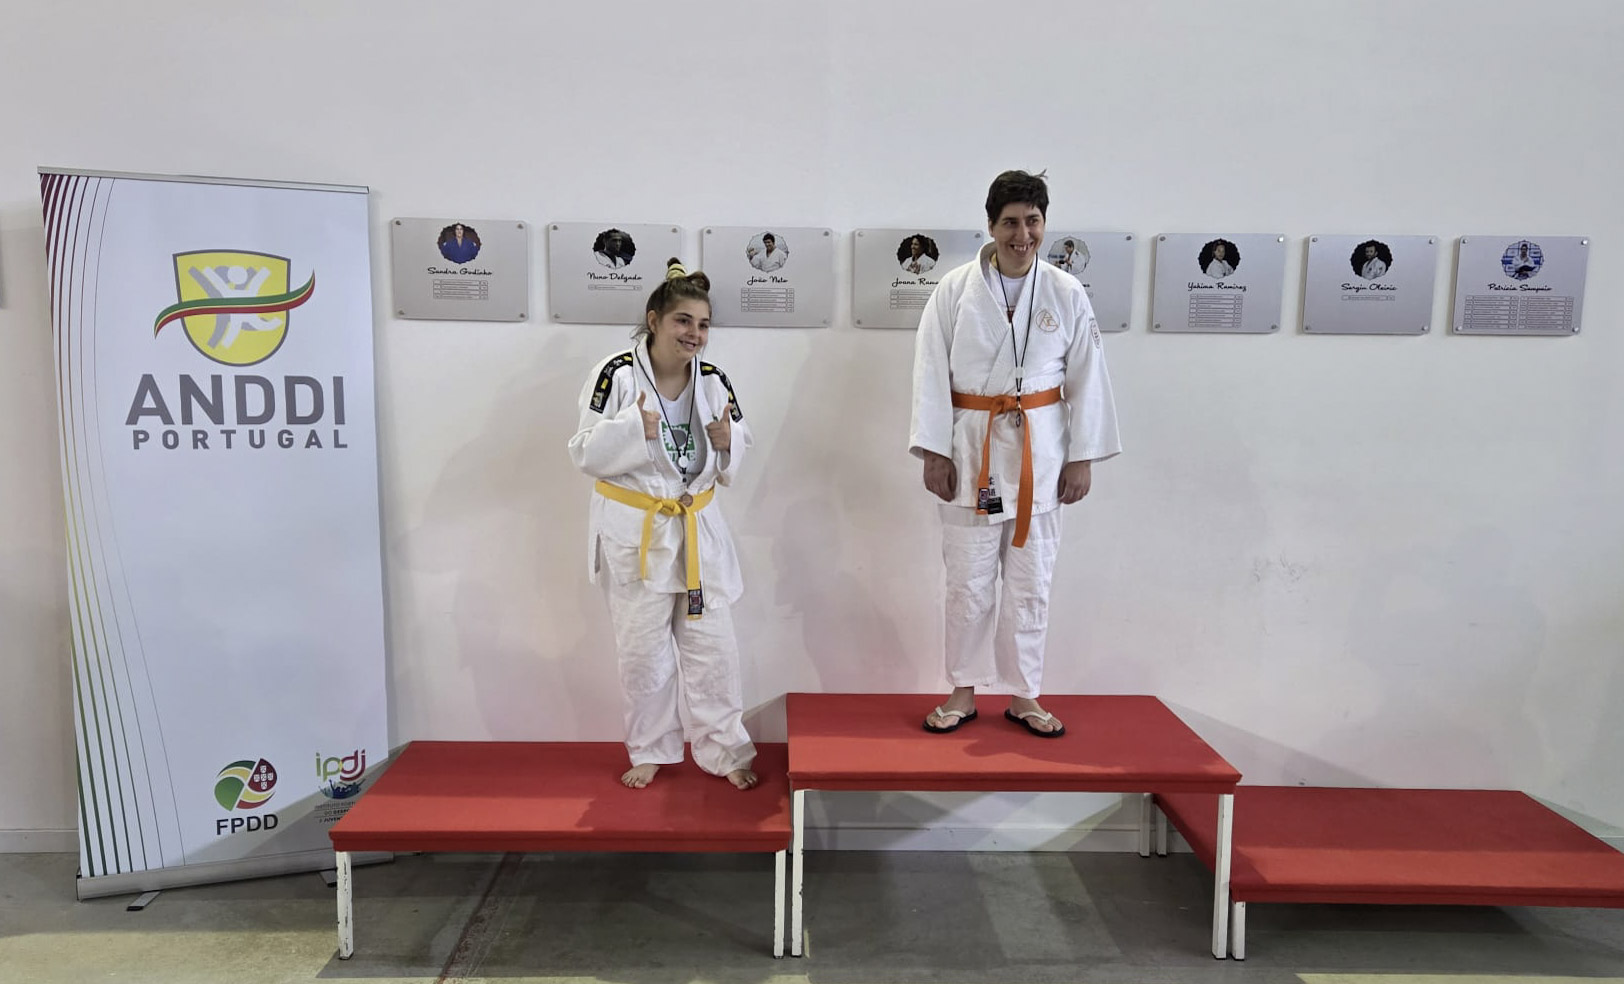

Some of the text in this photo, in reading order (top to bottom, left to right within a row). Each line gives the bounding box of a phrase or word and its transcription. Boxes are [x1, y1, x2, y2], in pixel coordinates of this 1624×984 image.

[427, 266, 493, 276] Sandra Godinho
[587, 272, 643, 283] Nuno Delgado
[769, 275, 788, 284] Neto
[891, 276, 940, 288] Joana Ramo
[1215, 281, 1247, 292] Ramirez
[1519, 283, 1553, 294] Sampaio
[125, 374, 345, 426] ANDDI
[133, 429, 348, 450] PORTUGAL
[315, 748, 366, 783] ipdj
[216, 813, 279, 836] FPDD
